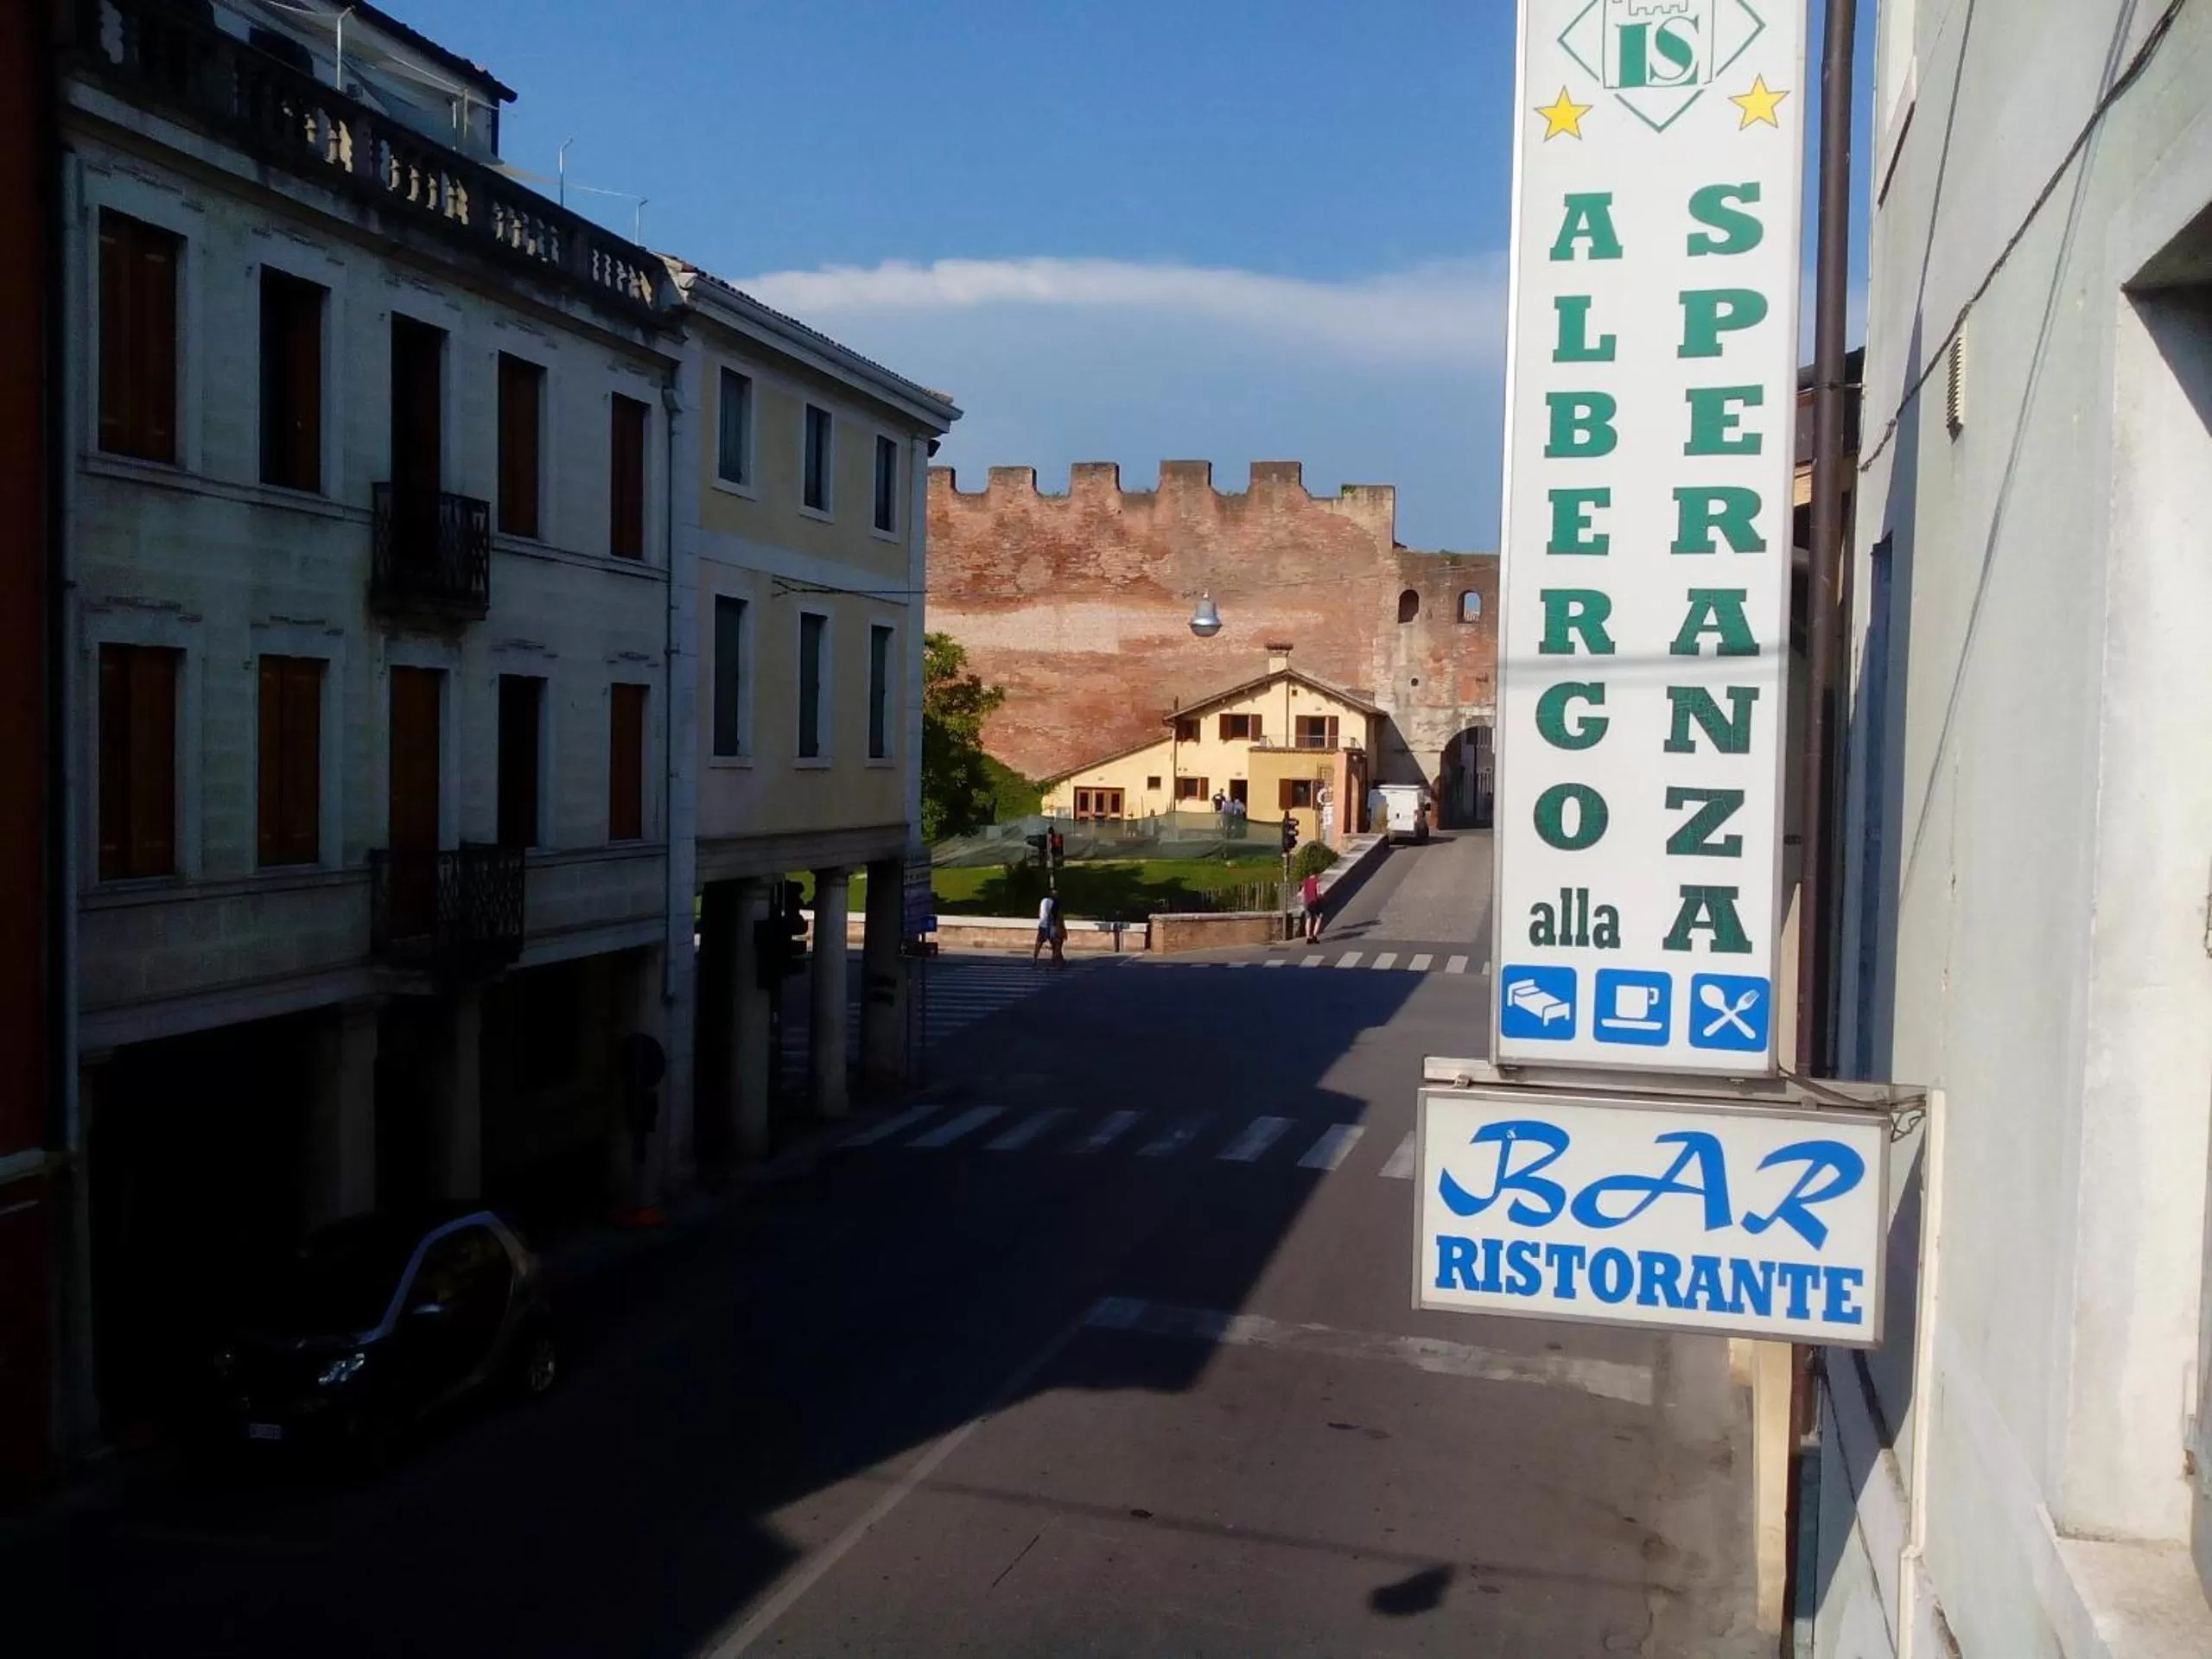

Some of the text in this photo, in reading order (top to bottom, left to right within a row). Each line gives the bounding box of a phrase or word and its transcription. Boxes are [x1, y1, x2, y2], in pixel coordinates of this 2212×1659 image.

[1533, 191, 1624, 851] ALBERGO
[1662, 181, 1769, 954] SPERANZA
[1529, 887, 1621, 949] alla
[1439, 1120, 1865, 1251] BAR
[1434, 1235, 1863, 1325] RISTORANTE
